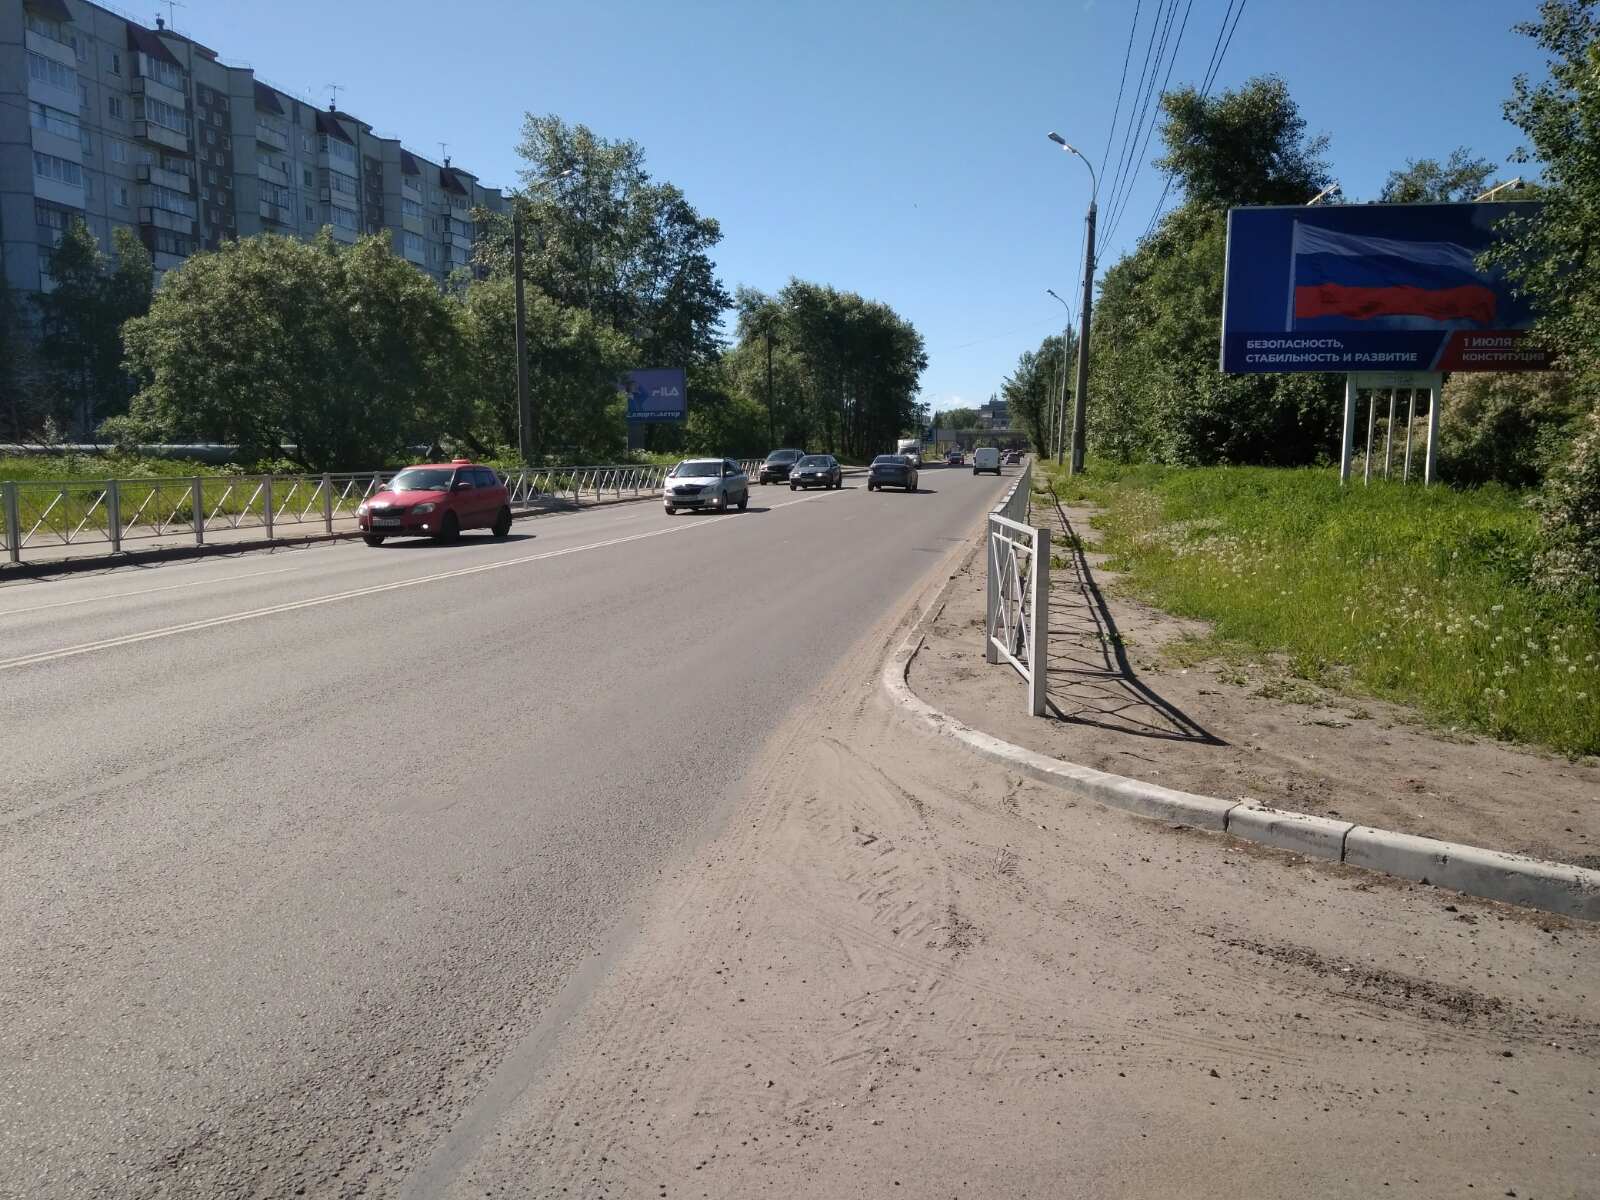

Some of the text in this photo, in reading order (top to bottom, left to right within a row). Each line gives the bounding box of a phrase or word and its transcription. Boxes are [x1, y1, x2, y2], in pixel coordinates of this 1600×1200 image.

[1246, 339, 1344, 349] БЕЗОПАСНОСТЬ,
[1463, 338, 1469, 347] 1
[1472, 337, 1512, 347] ИЮЛЯ
[1246, 352, 1418, 363] СТАБИЛЬНОСТЬ И РАЗВИТИЕ
[652, 386, 680, 397] FILA
